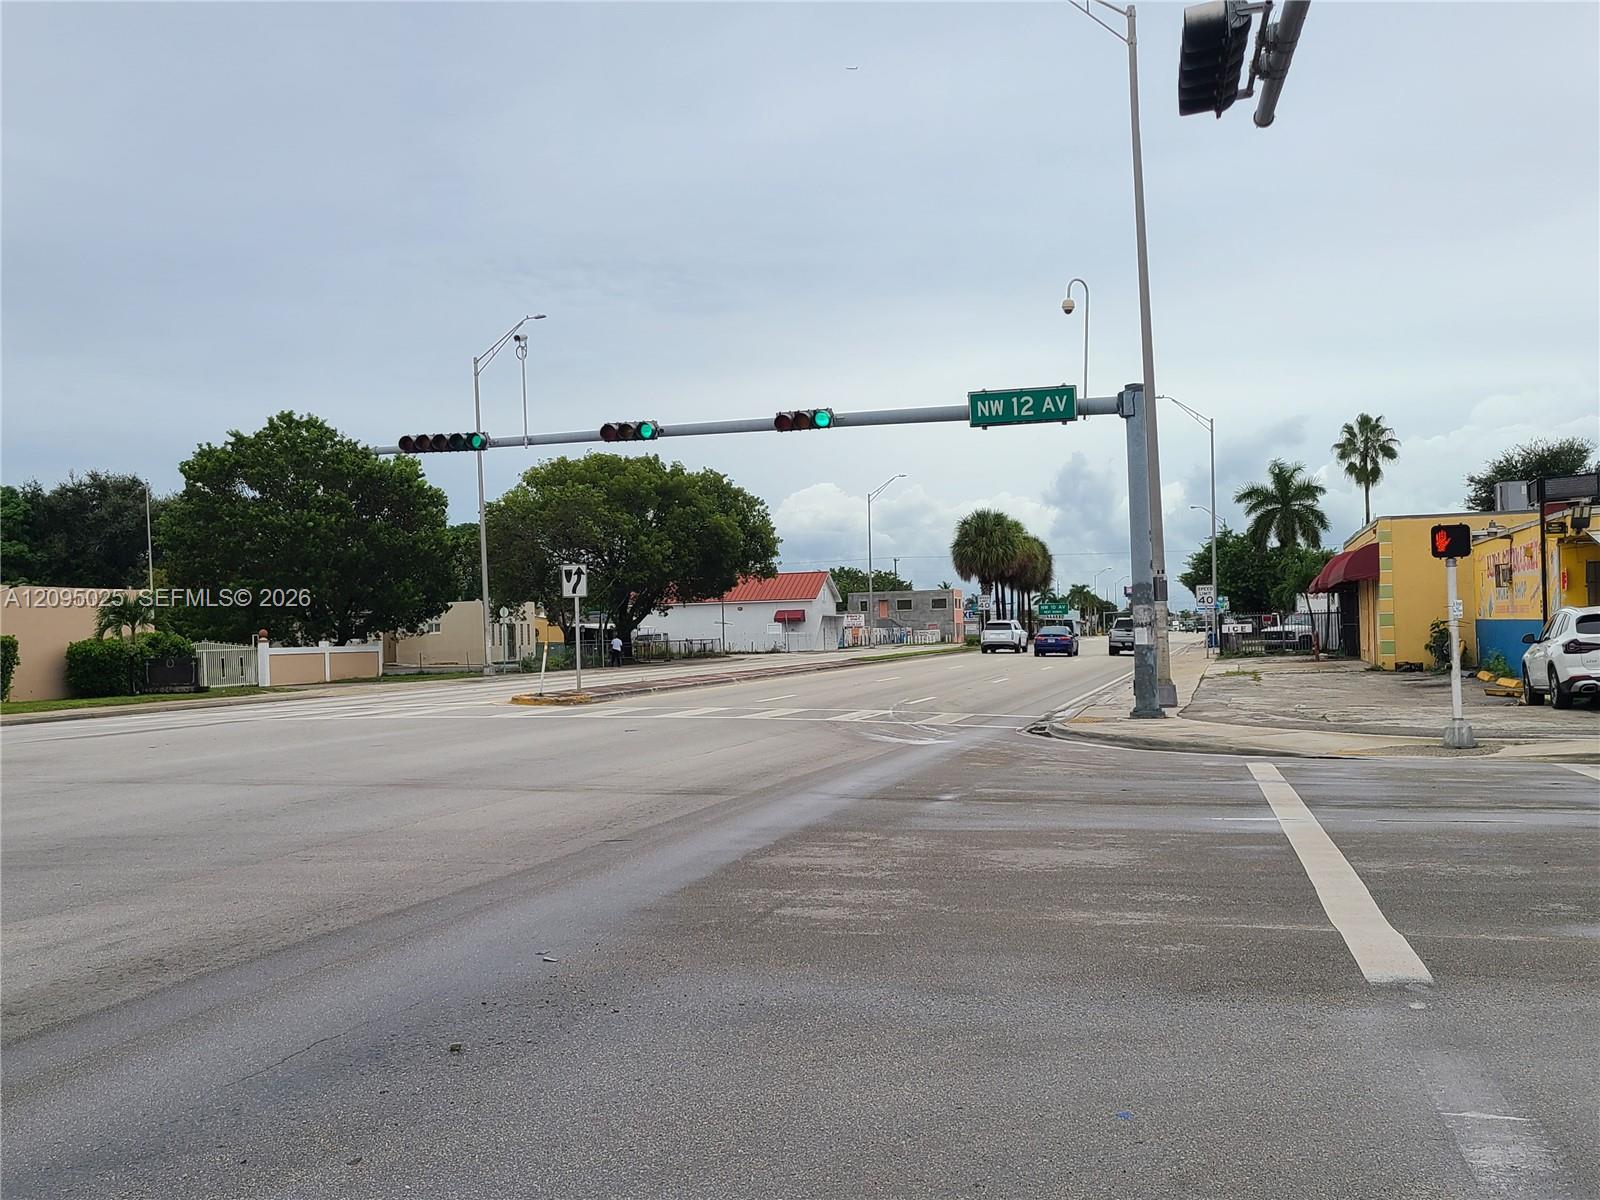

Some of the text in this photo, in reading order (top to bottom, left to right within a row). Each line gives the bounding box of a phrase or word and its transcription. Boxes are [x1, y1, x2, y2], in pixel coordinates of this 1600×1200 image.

[977, 395, 1067, 417] NW 12 AV
[1198, 596, 1214, 604] 40
